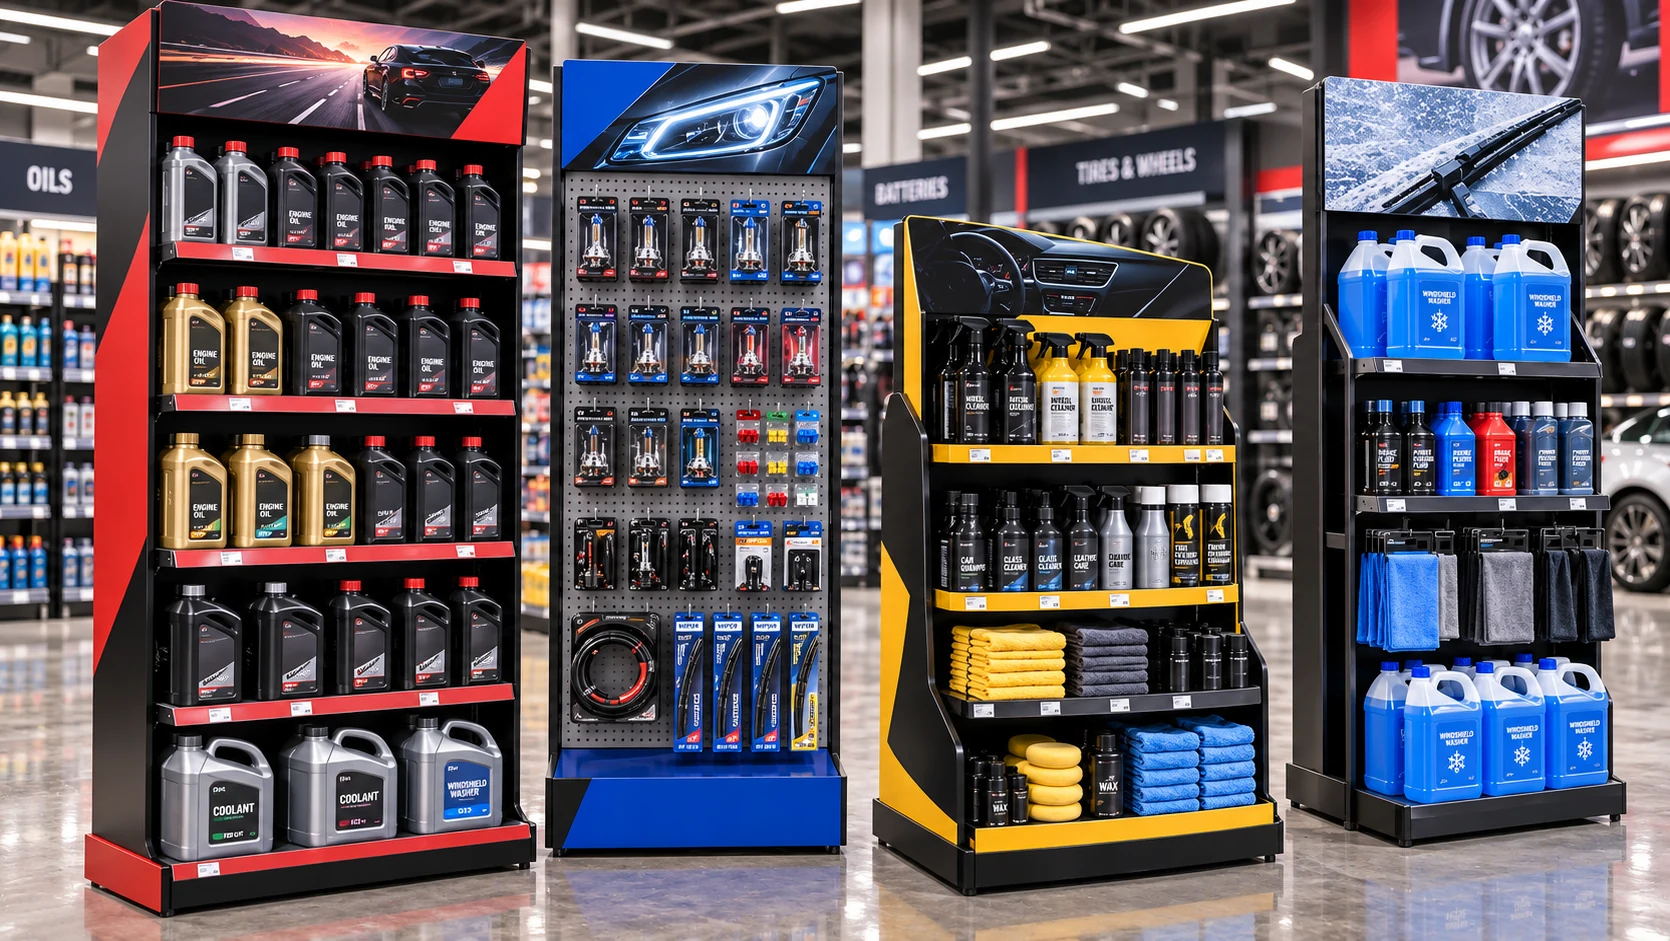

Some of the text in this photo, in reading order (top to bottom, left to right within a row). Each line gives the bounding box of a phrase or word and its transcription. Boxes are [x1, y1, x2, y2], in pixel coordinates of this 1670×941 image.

[1076, 147, 1197, 185] TIRES & WHEELS
[27, 165, 73, 195] OILS
[875, 176, 949, 206] BATTERIES
[260, 510, 272, 518] OIL
[447, 779, 487, 790] WINDSHIELD
[1099, 781, 1118, 792] WAX
[340, 791, 380, 805] COOLANT
[450, 788, 480, 798] WASHER
[213, 802, 255, 817] COOLANT
[992, 803, 1008, 813] WAX
